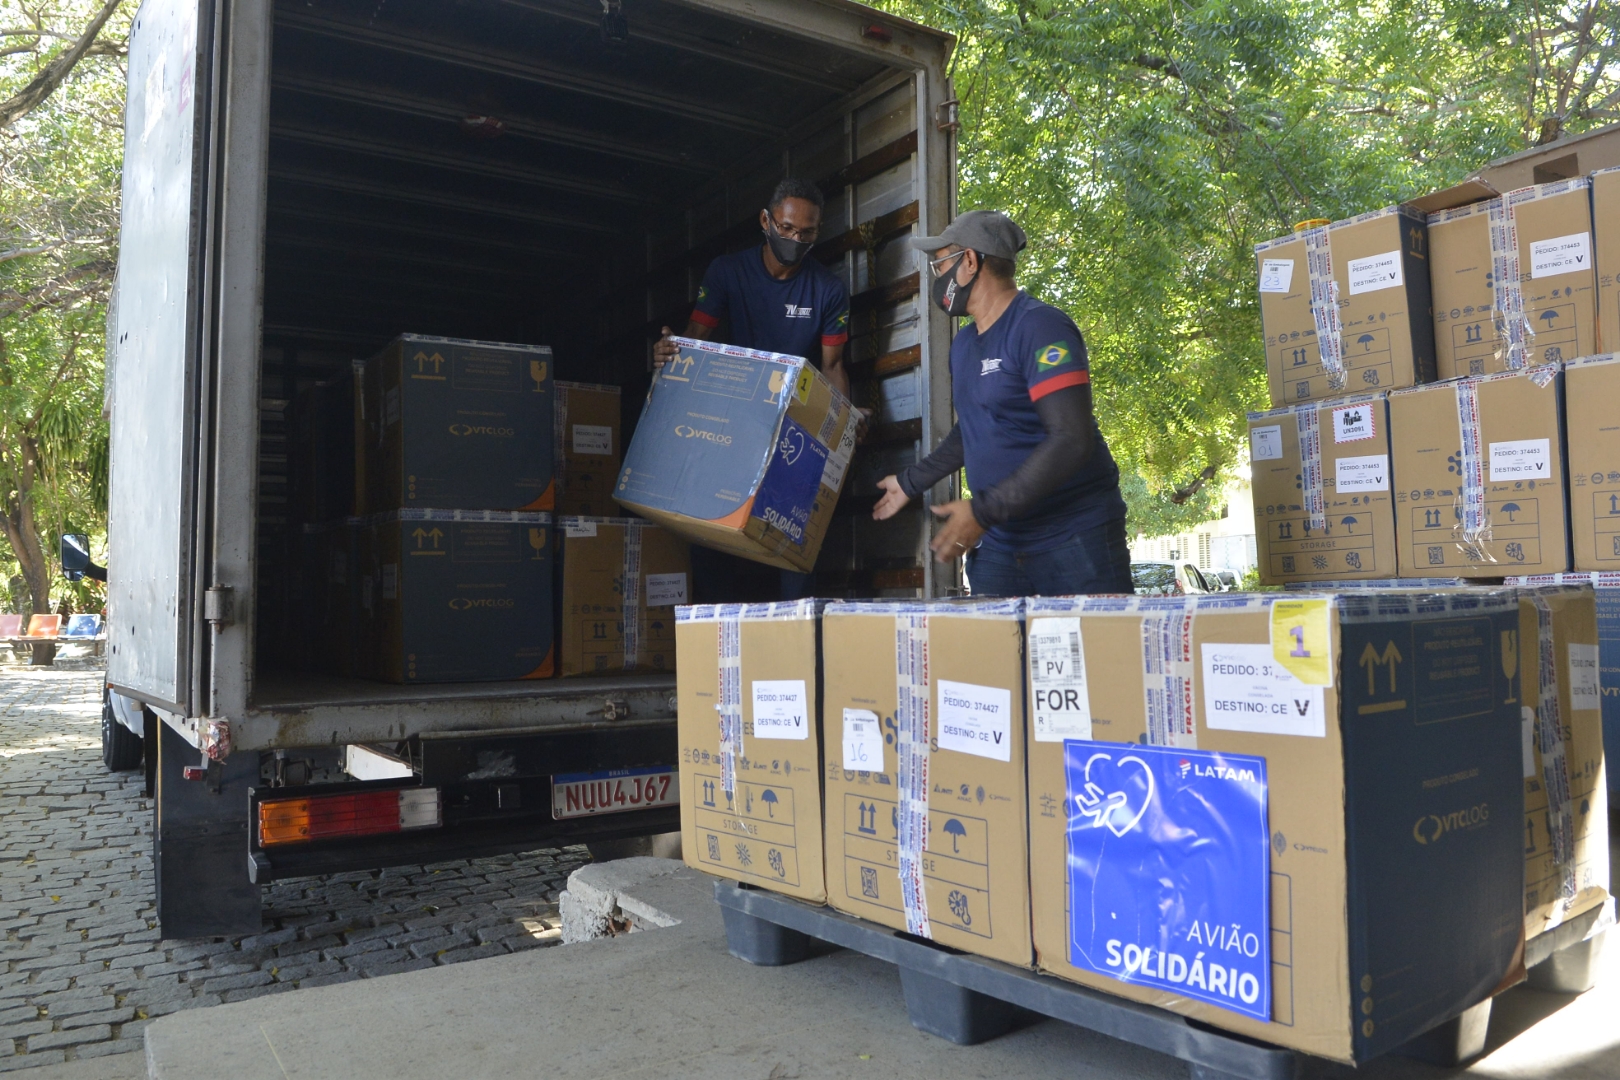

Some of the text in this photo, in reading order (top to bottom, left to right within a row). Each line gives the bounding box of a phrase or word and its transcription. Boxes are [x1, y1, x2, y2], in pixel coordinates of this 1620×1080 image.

[1535, 246, 1559, 255] PEDIDO:
[1352, 264, 1375, 273] PEDIDO:
[1535, 261, 1564, 270] DESTINO:
[1575, 254, 1584, 263] V
[1263, 275, 1280, 287] 23
[1353, 278, 1379, 287] DESTINO:
[1389, 272, 1396, 280] V
[800, 378, 808, 392] 1
[472, 426, 515, 436] VTCLOG
[695, 429, 732, 445] VTCLOG
[1343, 426, 1365, 435] UN3091
[1535, 462, 1544, 471] V
[1375, 476, 1382, 484] V
[790, 505, 808, 522] AVIÃO
[763, 506, 802, 539] SOLIDÁRIO
[1300, 540, 1337, 550] STORAGE
[1289, 625, 1311, 658] 1
[1046, 661, 1064, 675] PV
[1212, 664, 1259, 676] PEDIDO:
[756, 694, 778, 702] PEDIDO:
[1601, 687, 1620, 697] VT
[943, 696, 999, 714] PEDIDO: 374427
[1035, 689, 1081, 711] FOR
[1214, 699, 1310, 717] DESTINO: CE V
[758, 715, 801, 727] DESTINO: CE V
[1038, 716, 1045, 725] R
[943, 725, 1003, 745] DESTINO: CE V
[851, 742, 868, 762] 16
[608, 769, 630, 777] BRASIL
[1195, 763, 1256, 783] LATAM
[565, 775, 671, 812] NUU4J67
[1442, 802, 1489, 832] VTCLOG
[723, 819, 758, 835] STORAGE
[886, 850, 936, 873] STGE
[1186, 919, 1259, 958] AVIÃO
[1105, 938, 1260, 1005] SOLIDÁRIO
